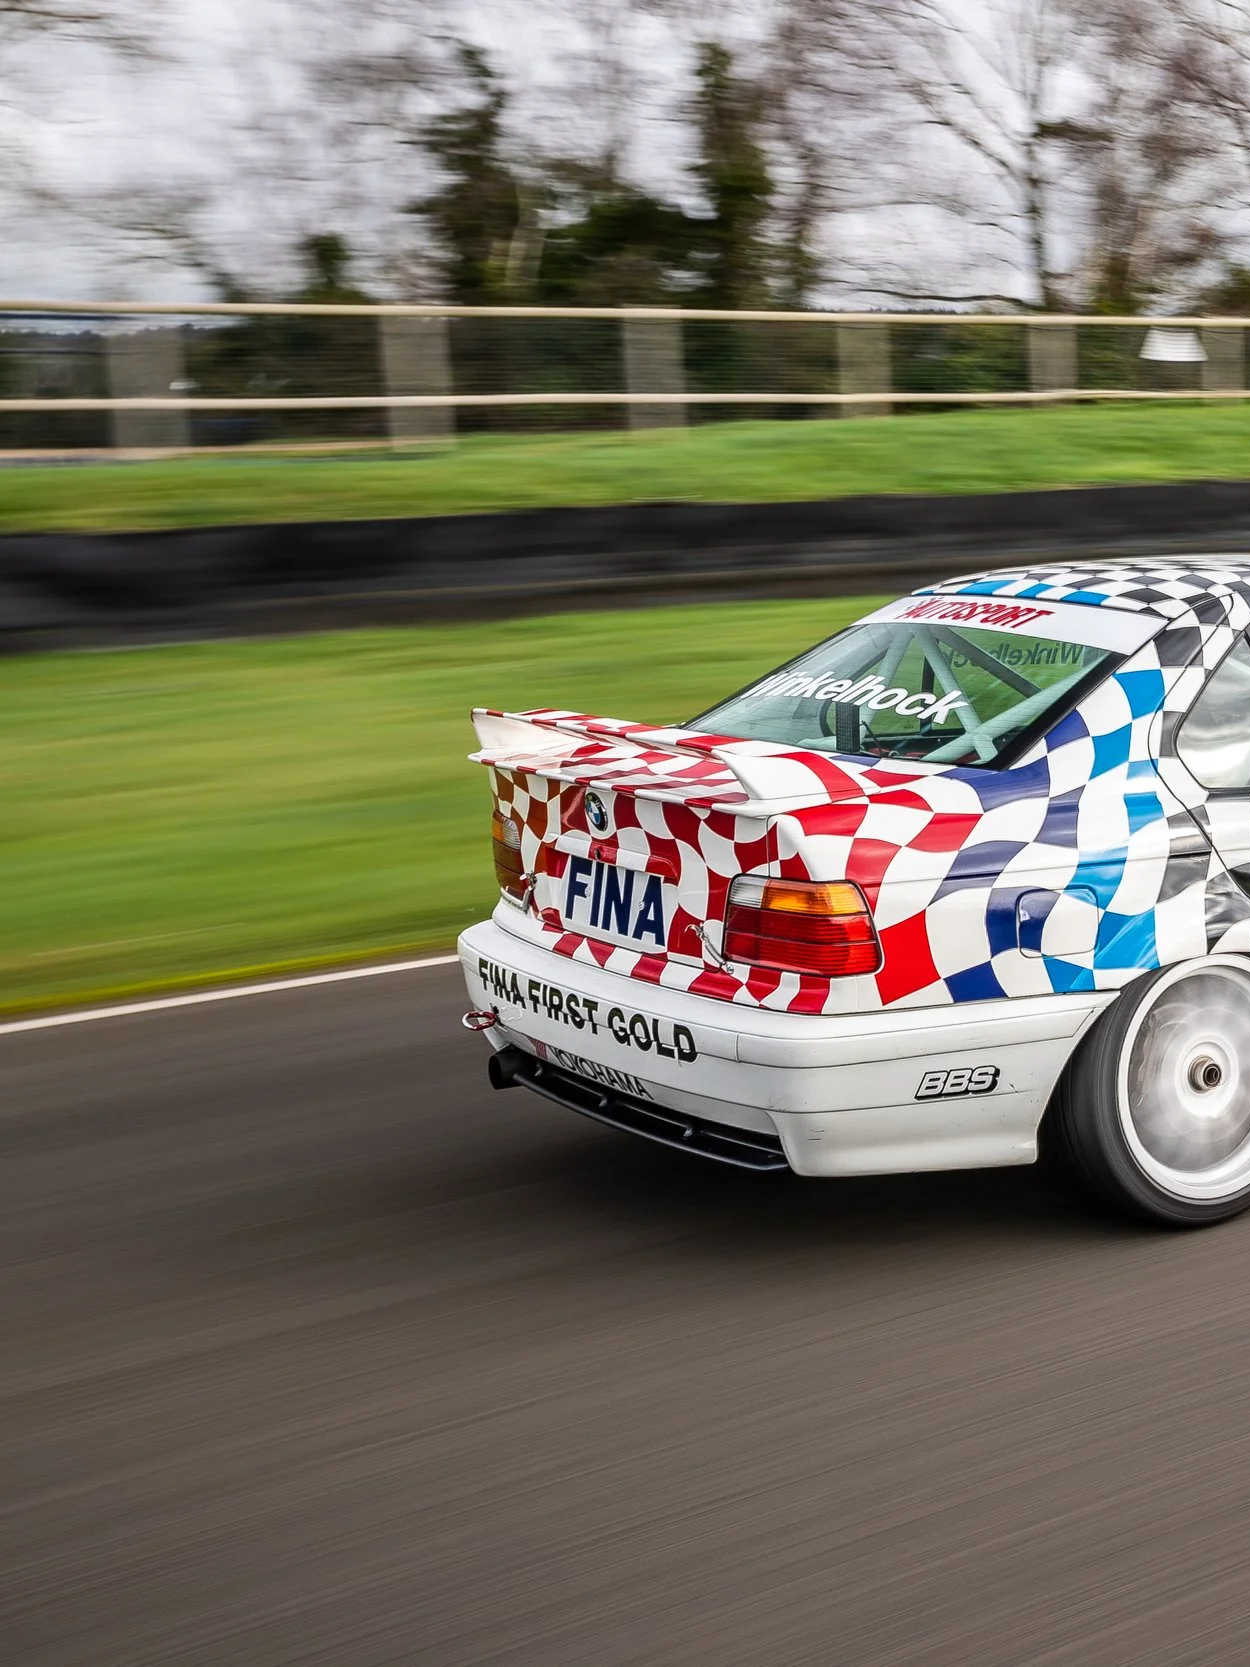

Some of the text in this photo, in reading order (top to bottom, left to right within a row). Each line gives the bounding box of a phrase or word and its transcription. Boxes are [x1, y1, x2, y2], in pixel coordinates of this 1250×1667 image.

[894, 599, 1056, 629] AUTOSPORT
[740, 671, 970, 725] Winkelhock
[564, 855, 666, 947] FINA
[478, 957, 699, 1064] FINA FIRST GOLD
[914, 1065, 1001, 1101] BBS
